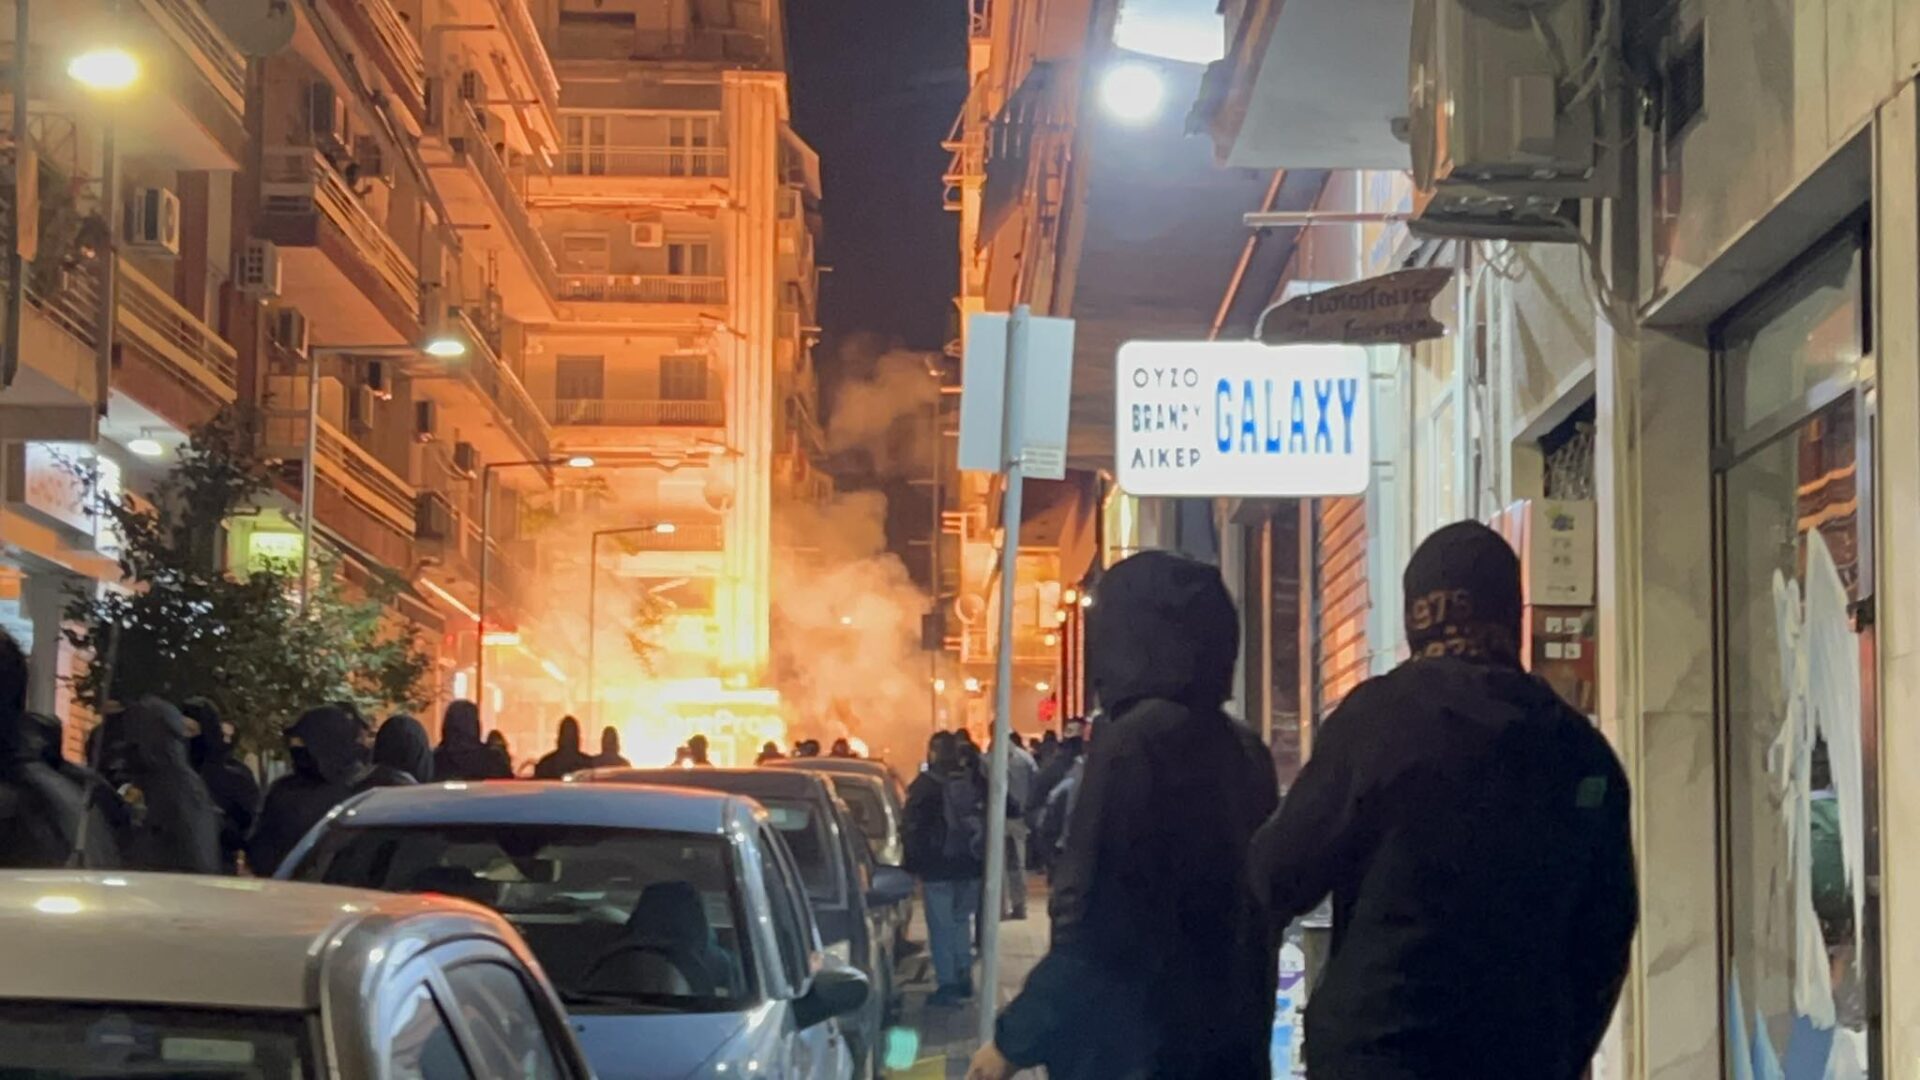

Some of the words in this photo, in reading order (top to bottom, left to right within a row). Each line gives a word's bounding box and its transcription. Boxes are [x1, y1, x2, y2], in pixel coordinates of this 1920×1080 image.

[1132, 367, 1199, 389] ΟΥΖΟ
[1215, 377, 1358, 455] GALAXY
[1130, 447, 1201, 470] ΛΙΚΕΡ
